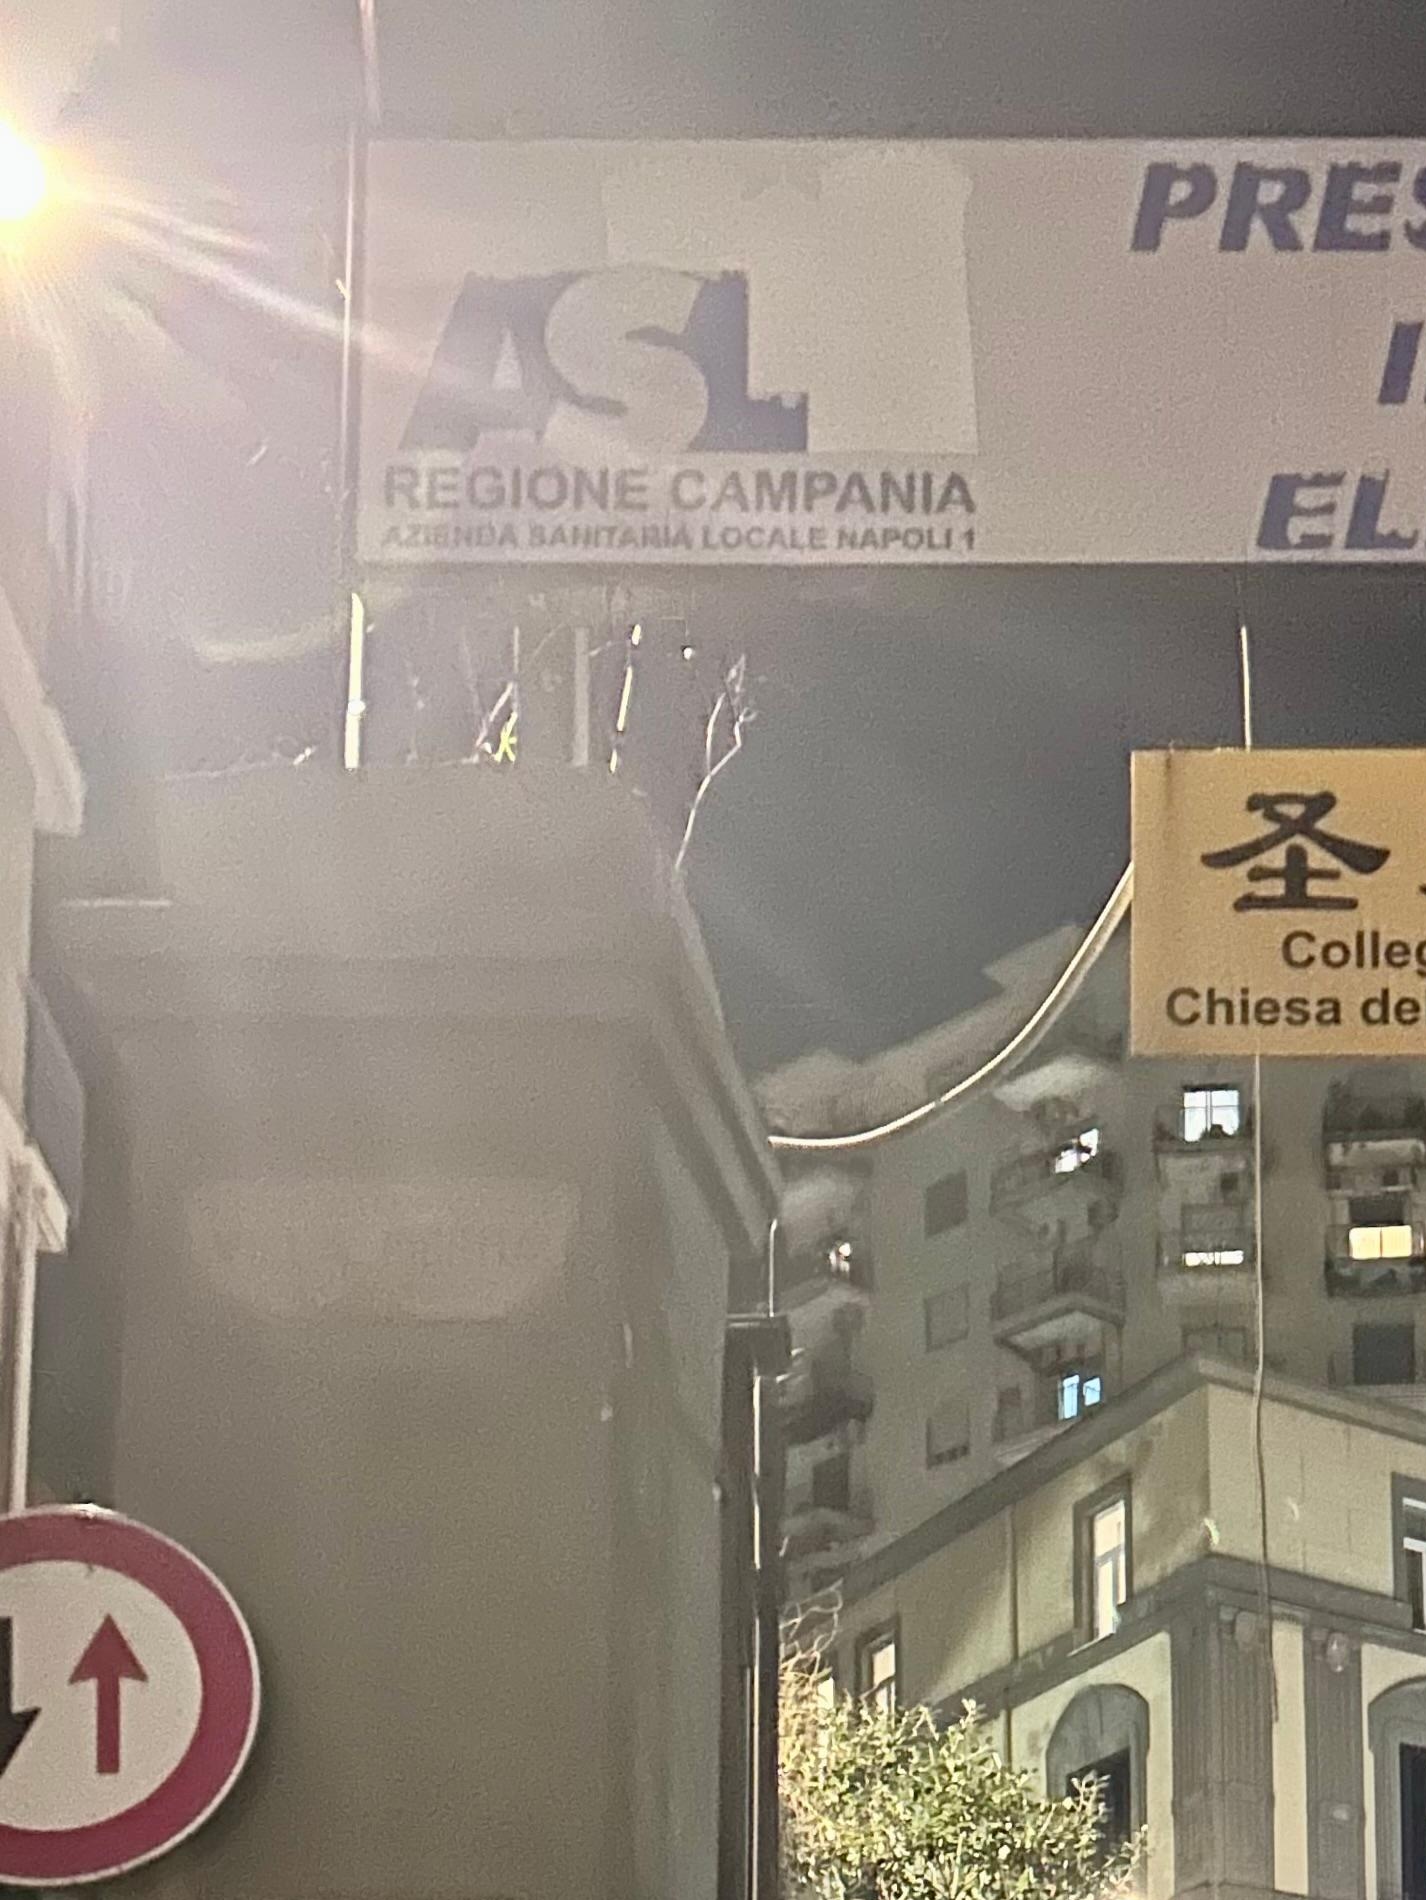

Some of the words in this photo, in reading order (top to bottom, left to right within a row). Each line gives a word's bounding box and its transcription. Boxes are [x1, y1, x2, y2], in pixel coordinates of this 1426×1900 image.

[400, 263, 809, 453] ASL
[384, 465, 649, 511] REGIONE
[670, 467, 977, 513] CAMPANIA
[381, 523, 518, 548] AZIENDA
[527, 522, 693, 549] SANITARIA
[701, 525, 827, 550] LOCALE
[836, 526, 952, 550] NAPOLI
[960, 526, 976, 550] 1
[1165, 984, 1342, 1028] Chiesa
